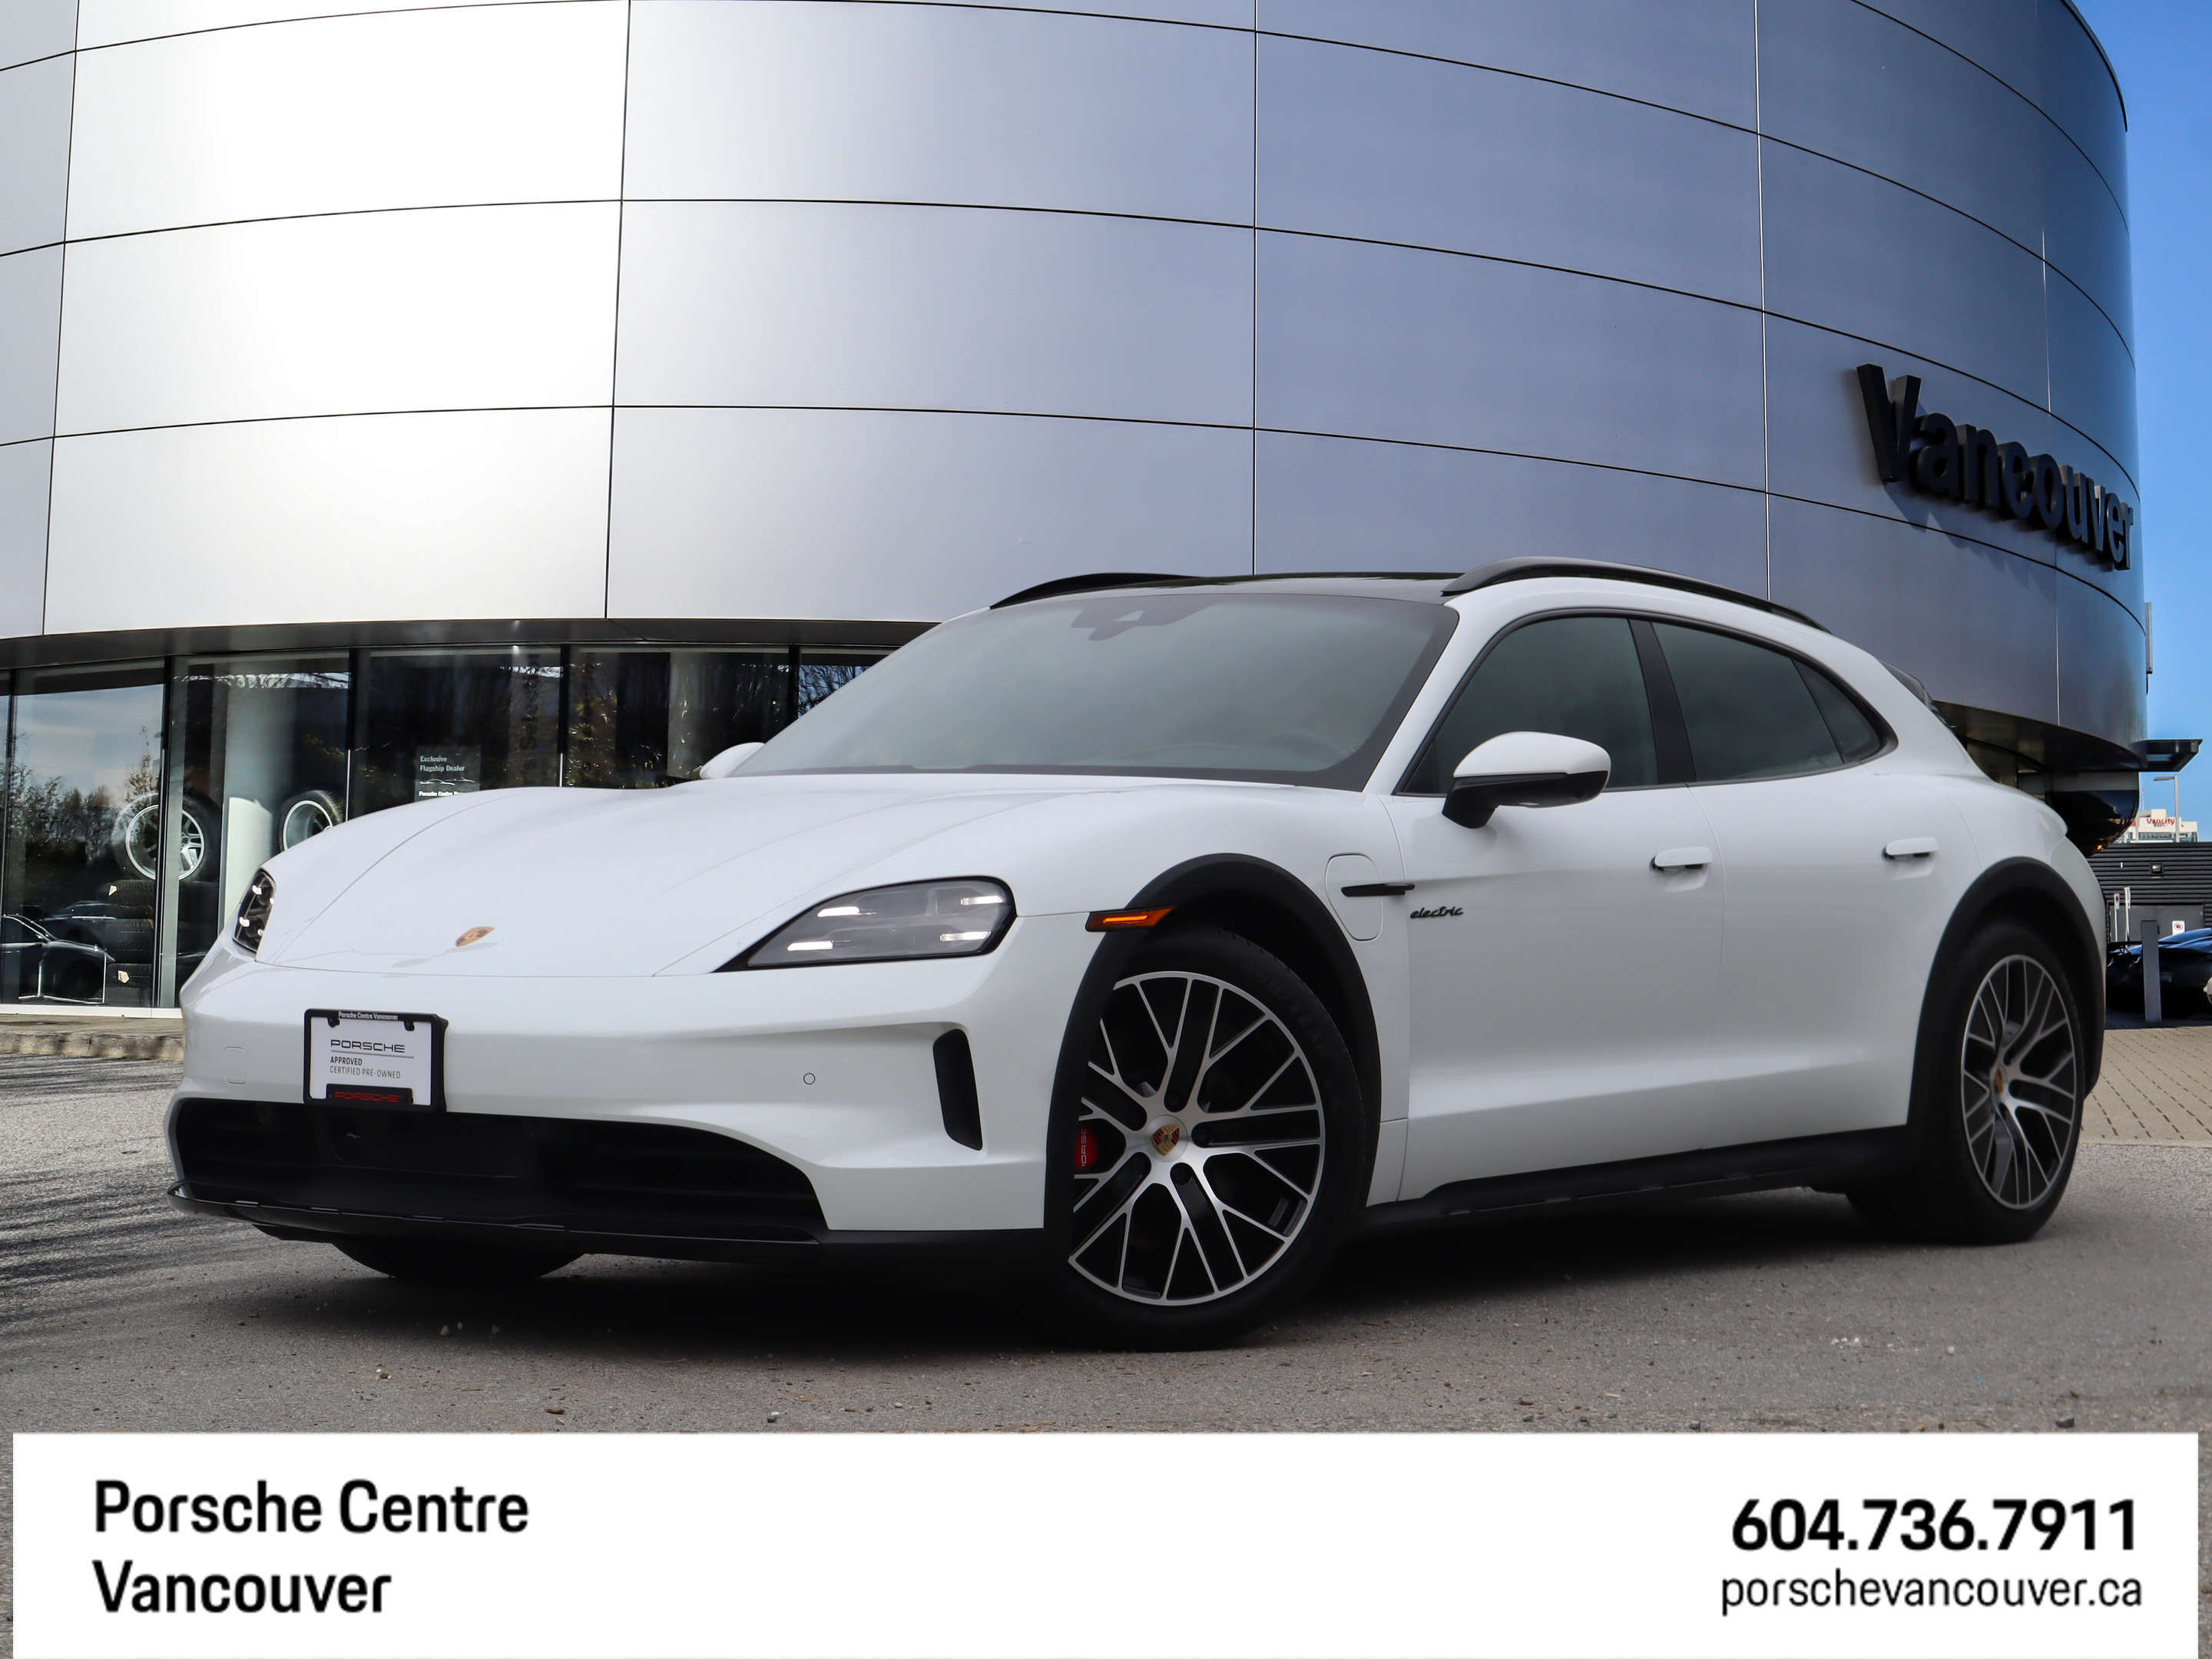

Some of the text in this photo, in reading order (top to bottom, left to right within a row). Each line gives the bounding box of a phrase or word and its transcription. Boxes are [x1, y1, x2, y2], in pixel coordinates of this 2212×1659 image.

[1856, 363, 2134, 571] Vancouver
[1410, 906, 1464, 919] electric
[330, 1039, 405, 1053] PORSCHE
[330, 1056, 363, 1066] APPROVED
[329, 1065, 401, 1079] CERTIFIED PRE-OWNED
[335, 1091, 399, 1103] PORSCHE
